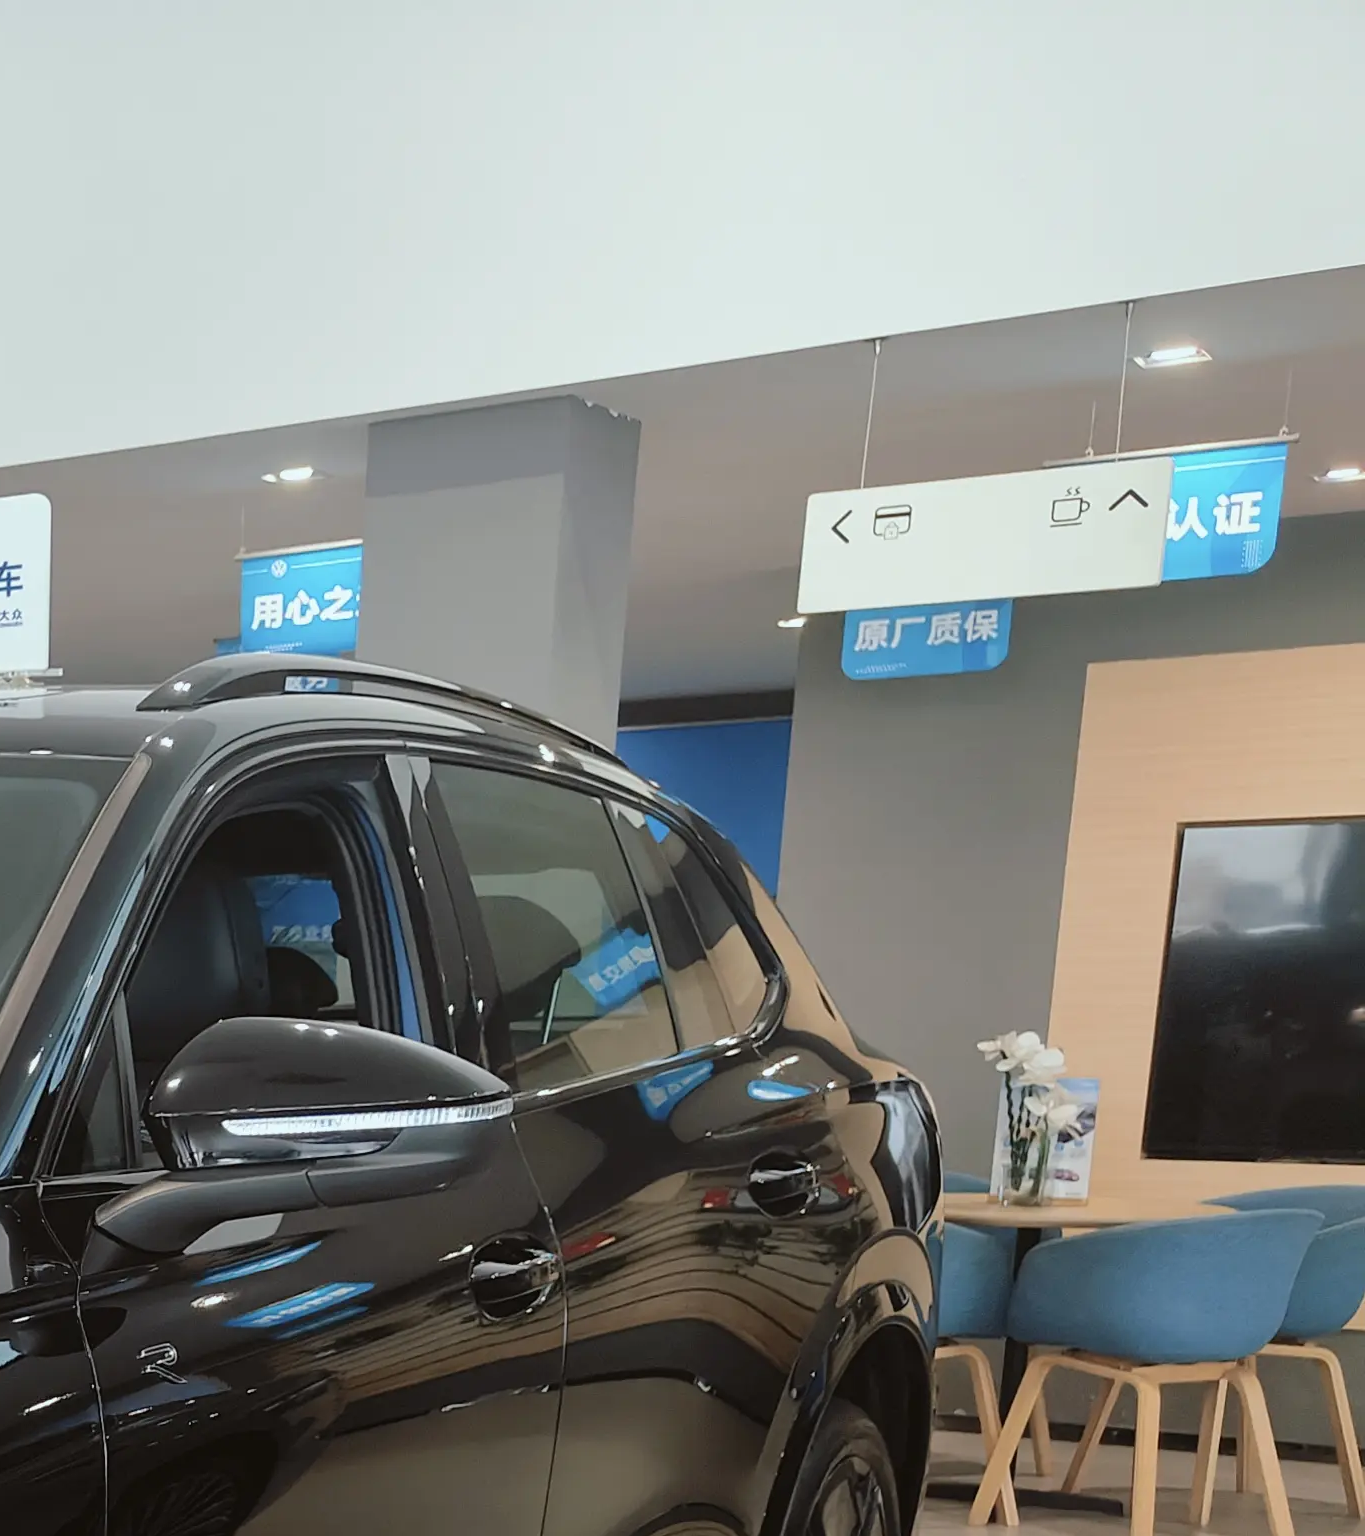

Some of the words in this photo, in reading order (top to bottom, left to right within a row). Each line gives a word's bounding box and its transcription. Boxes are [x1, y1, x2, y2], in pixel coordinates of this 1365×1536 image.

[1166, 491, 1263, 541] 认证
[251, 585, 360, 632] 用心之
[854, 609, 999, 652] 原厂质保
